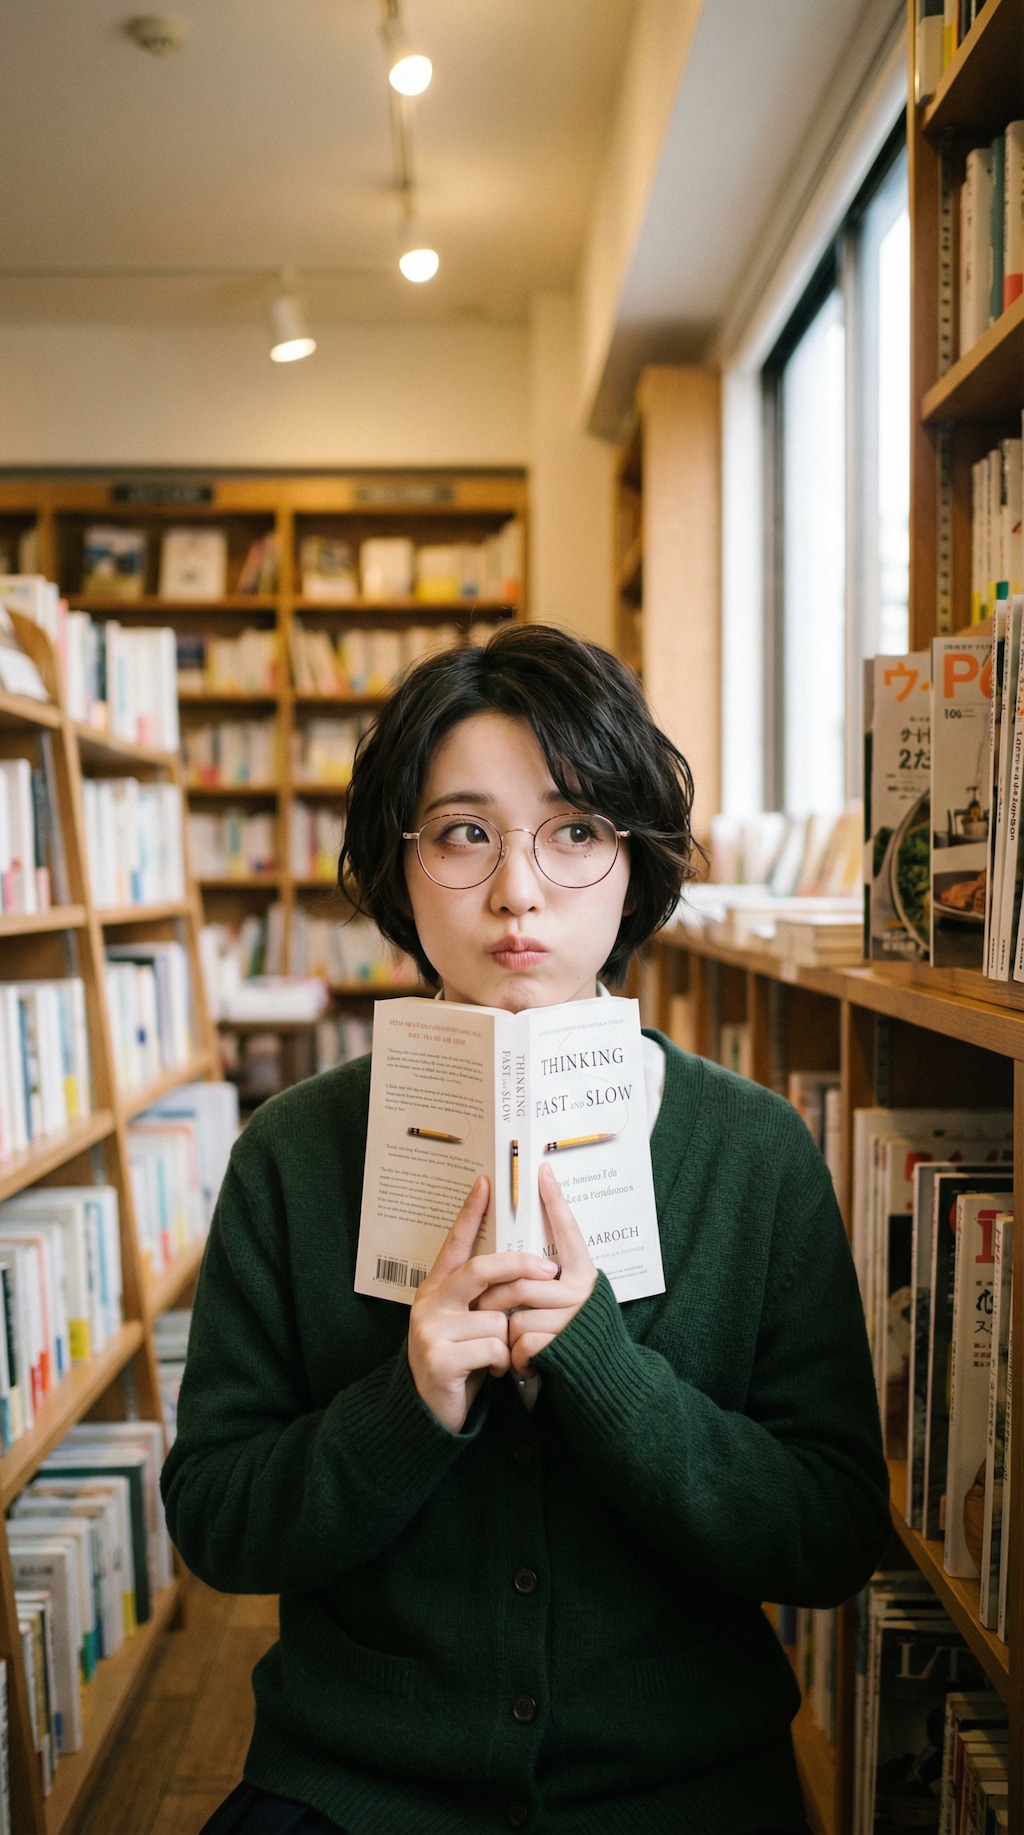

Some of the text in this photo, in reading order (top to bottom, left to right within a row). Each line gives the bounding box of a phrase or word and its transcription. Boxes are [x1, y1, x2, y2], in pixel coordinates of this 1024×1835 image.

[502, 1050, 511, 1078] FAST
[541, 1047, 624, 1076] THINKING
[516, 1054, 526, 1117] THINKING
[502, 1091, 511, 1123] SLOW
[535, 1084, 632, 1118] FAST AND SLOW
[587, 1226, 639, 1247] AAROCH
